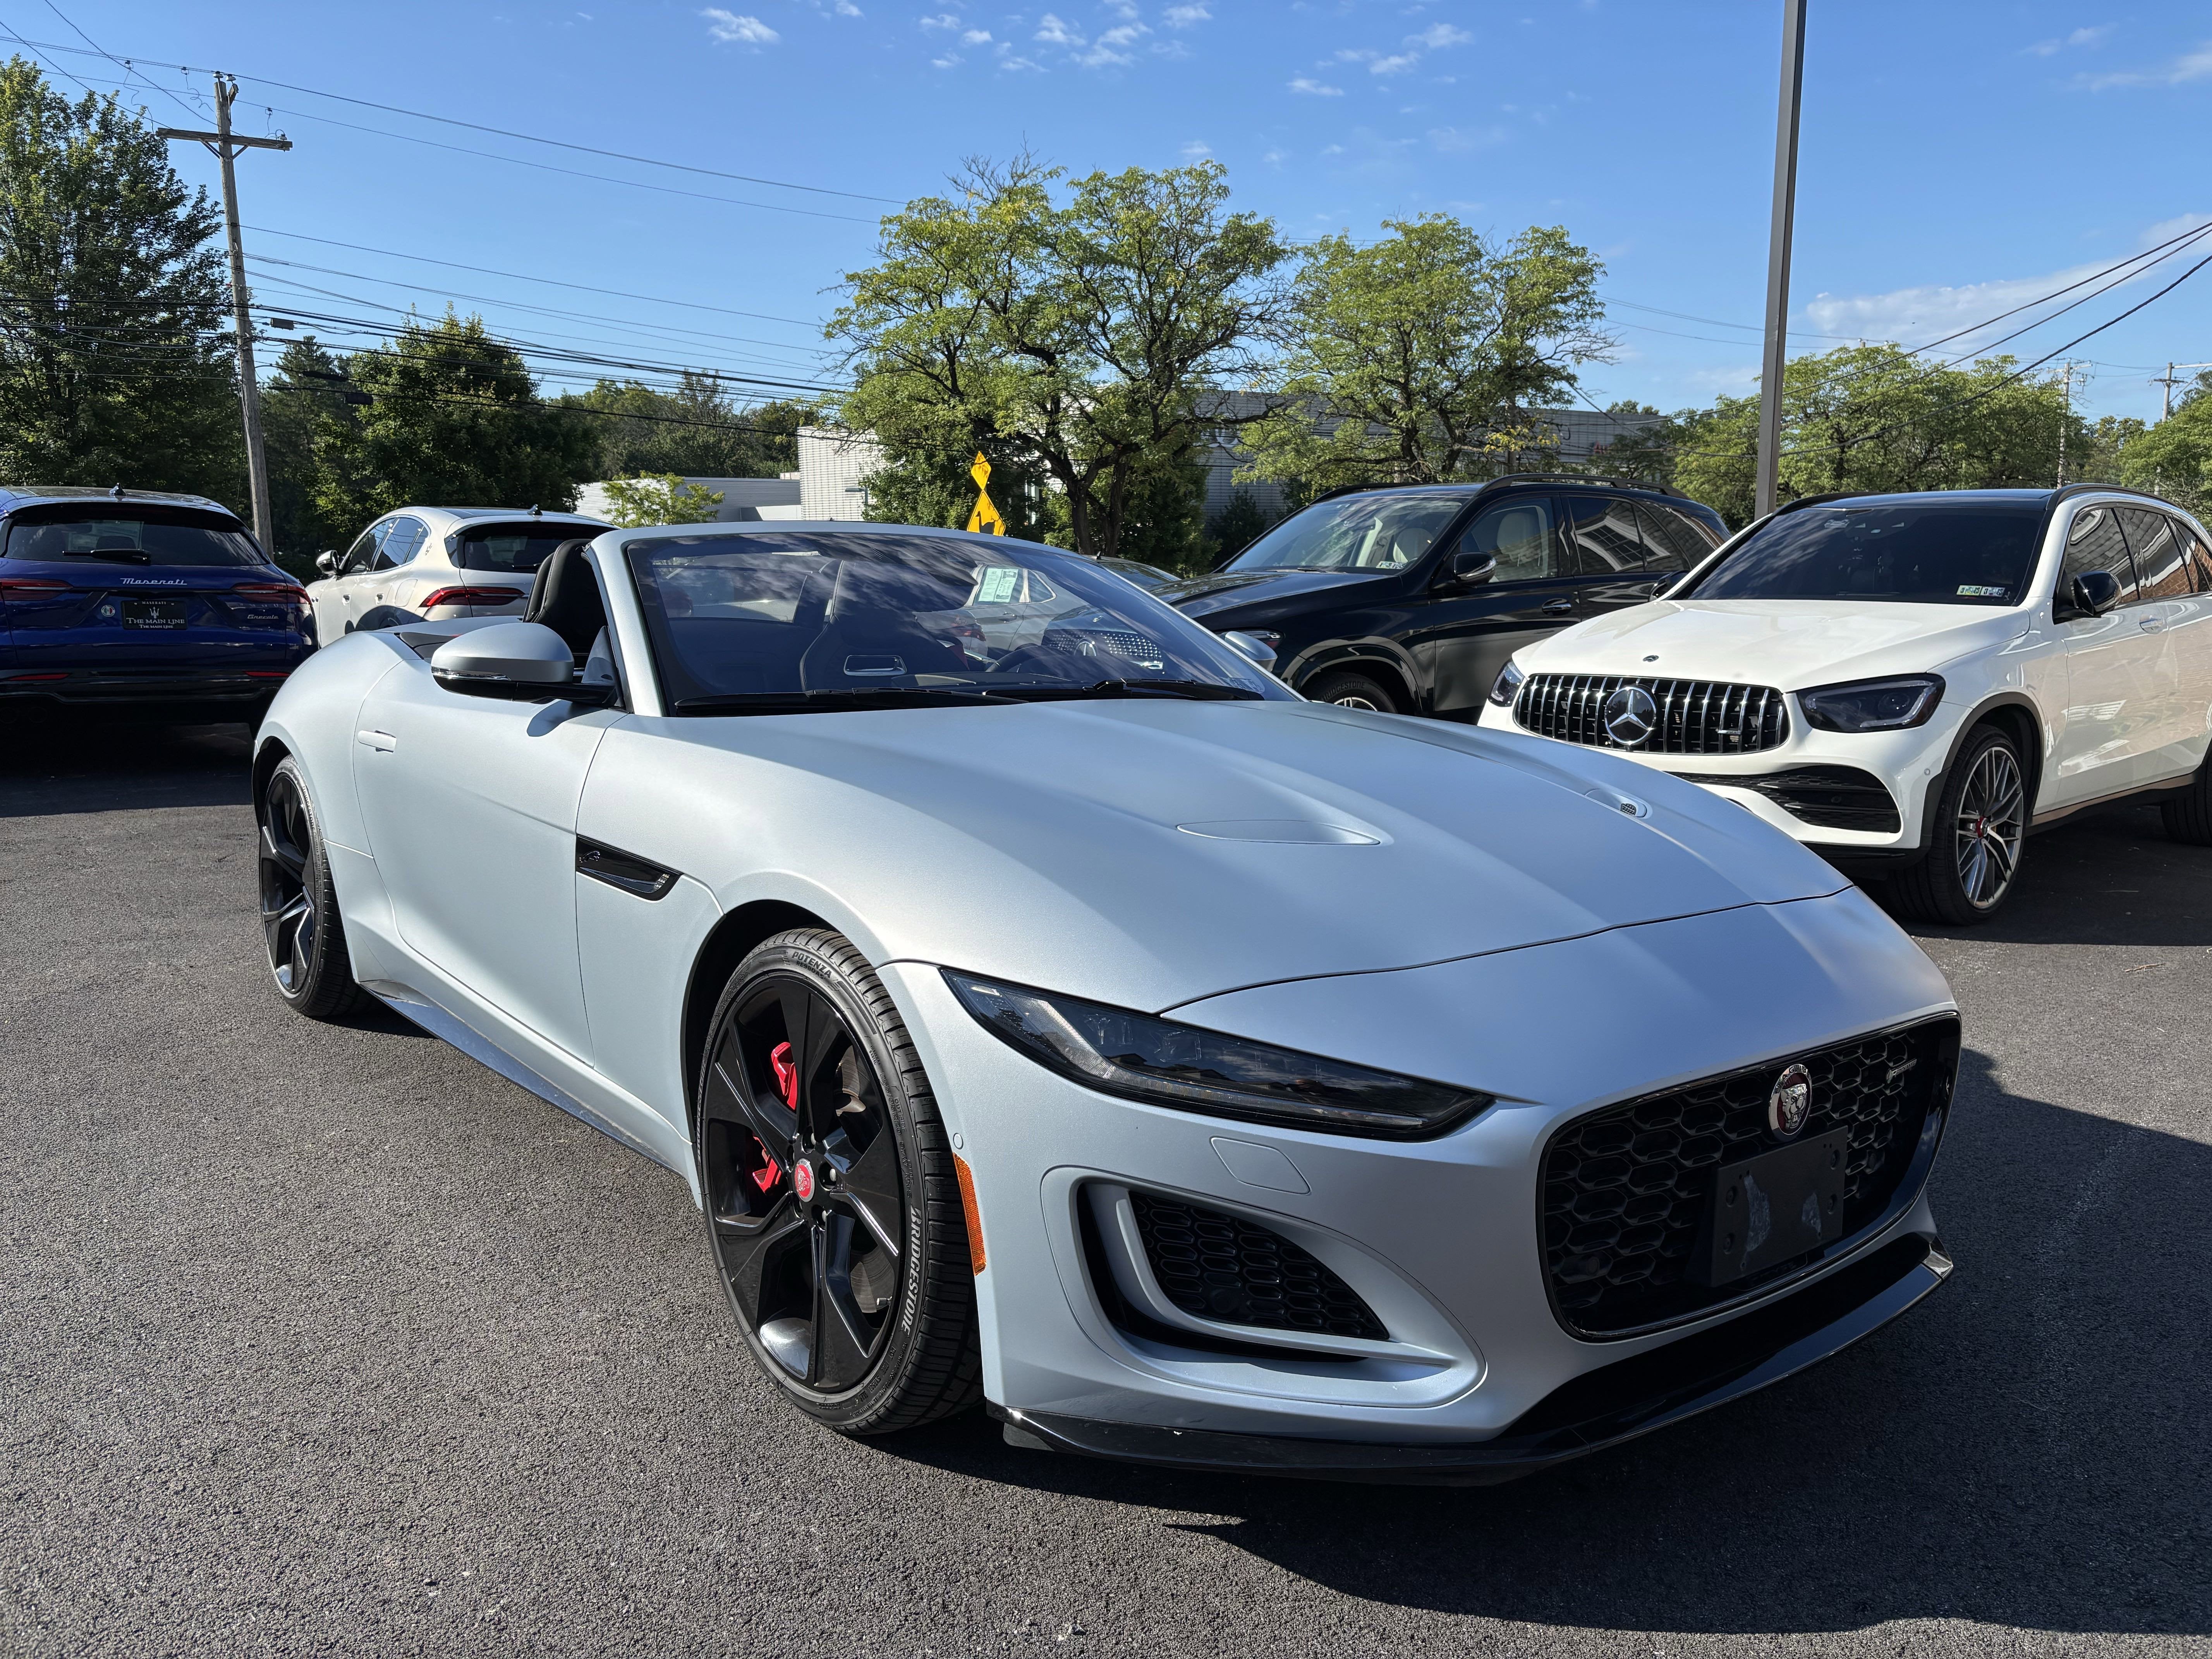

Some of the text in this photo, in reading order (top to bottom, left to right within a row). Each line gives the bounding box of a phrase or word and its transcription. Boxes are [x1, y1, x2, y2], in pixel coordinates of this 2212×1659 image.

[792, 951, 832, 979] POTENZA
[894, 1097, 907, 1132] OUTSIDE
[902, 1203, 922, 1337] BRIDGESTONE
